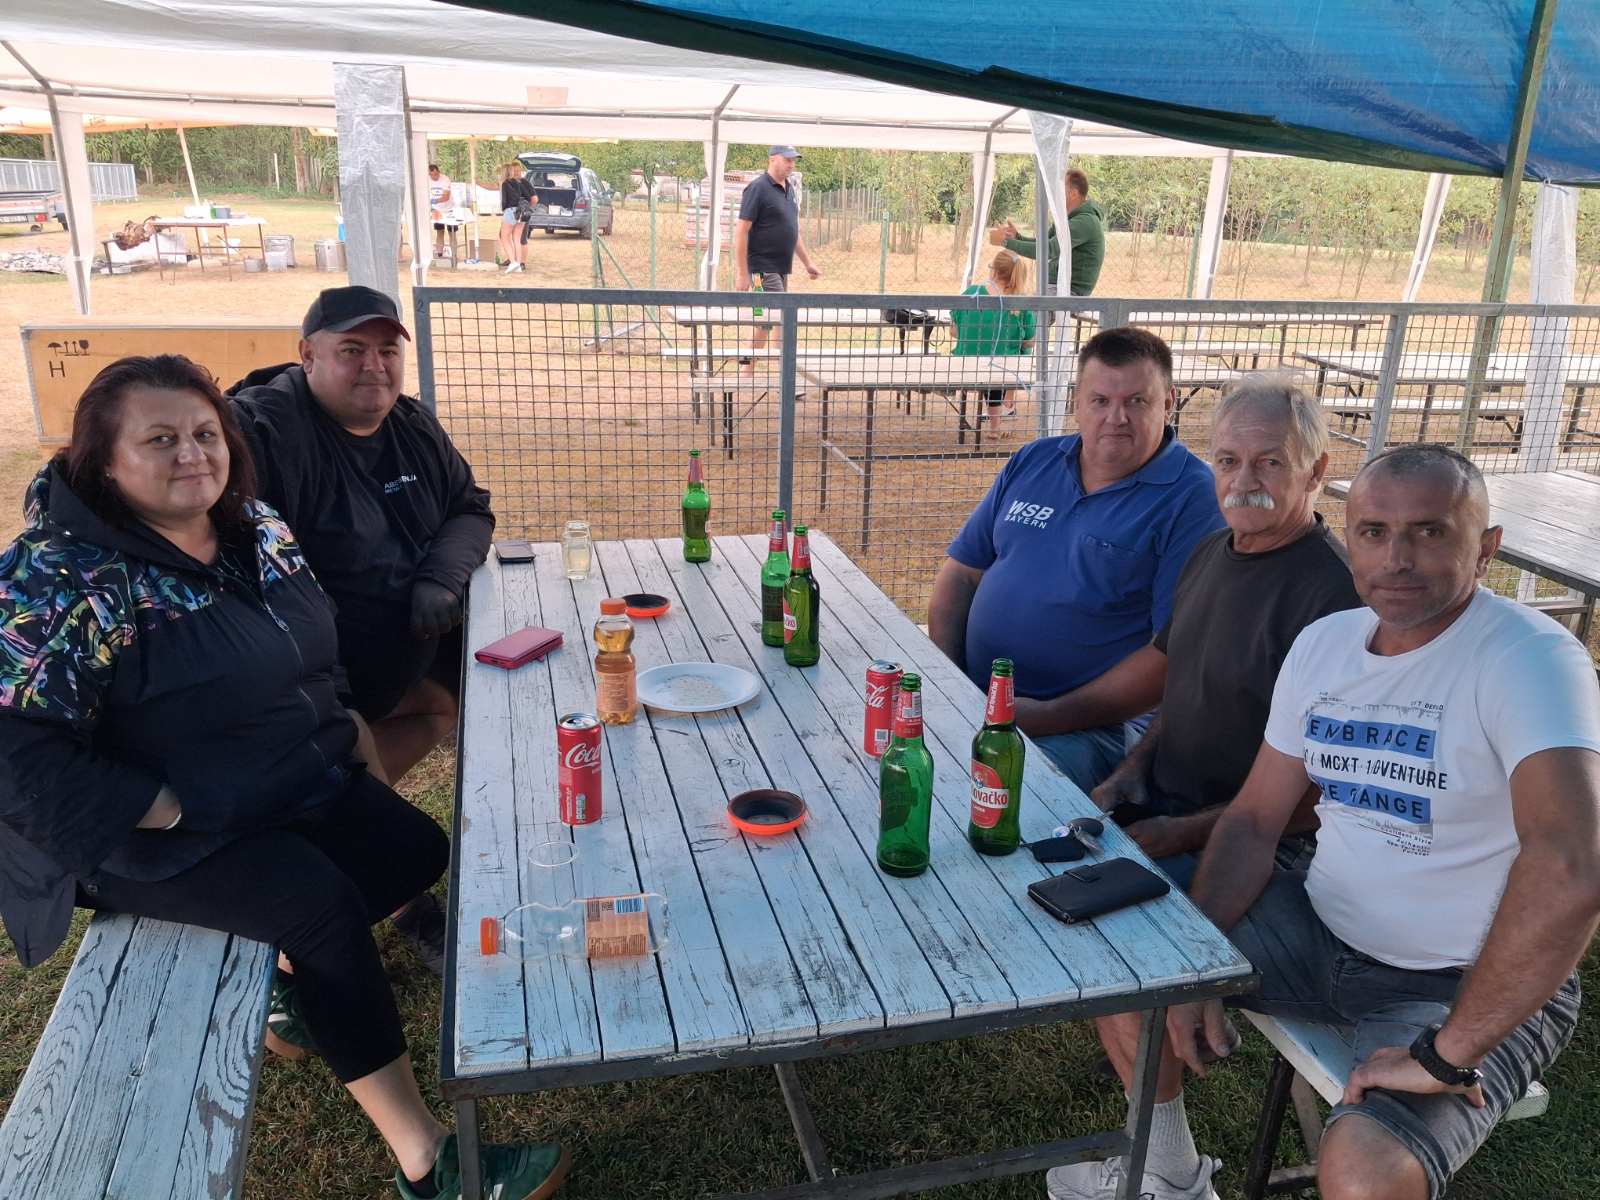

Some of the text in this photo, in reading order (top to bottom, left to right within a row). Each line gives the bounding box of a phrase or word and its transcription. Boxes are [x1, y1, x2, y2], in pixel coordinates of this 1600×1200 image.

[49, 361, 66, 378] H
[1008, 500, 1054, 520] WSB
[1004, 514, 1047, 529] BAYERN
